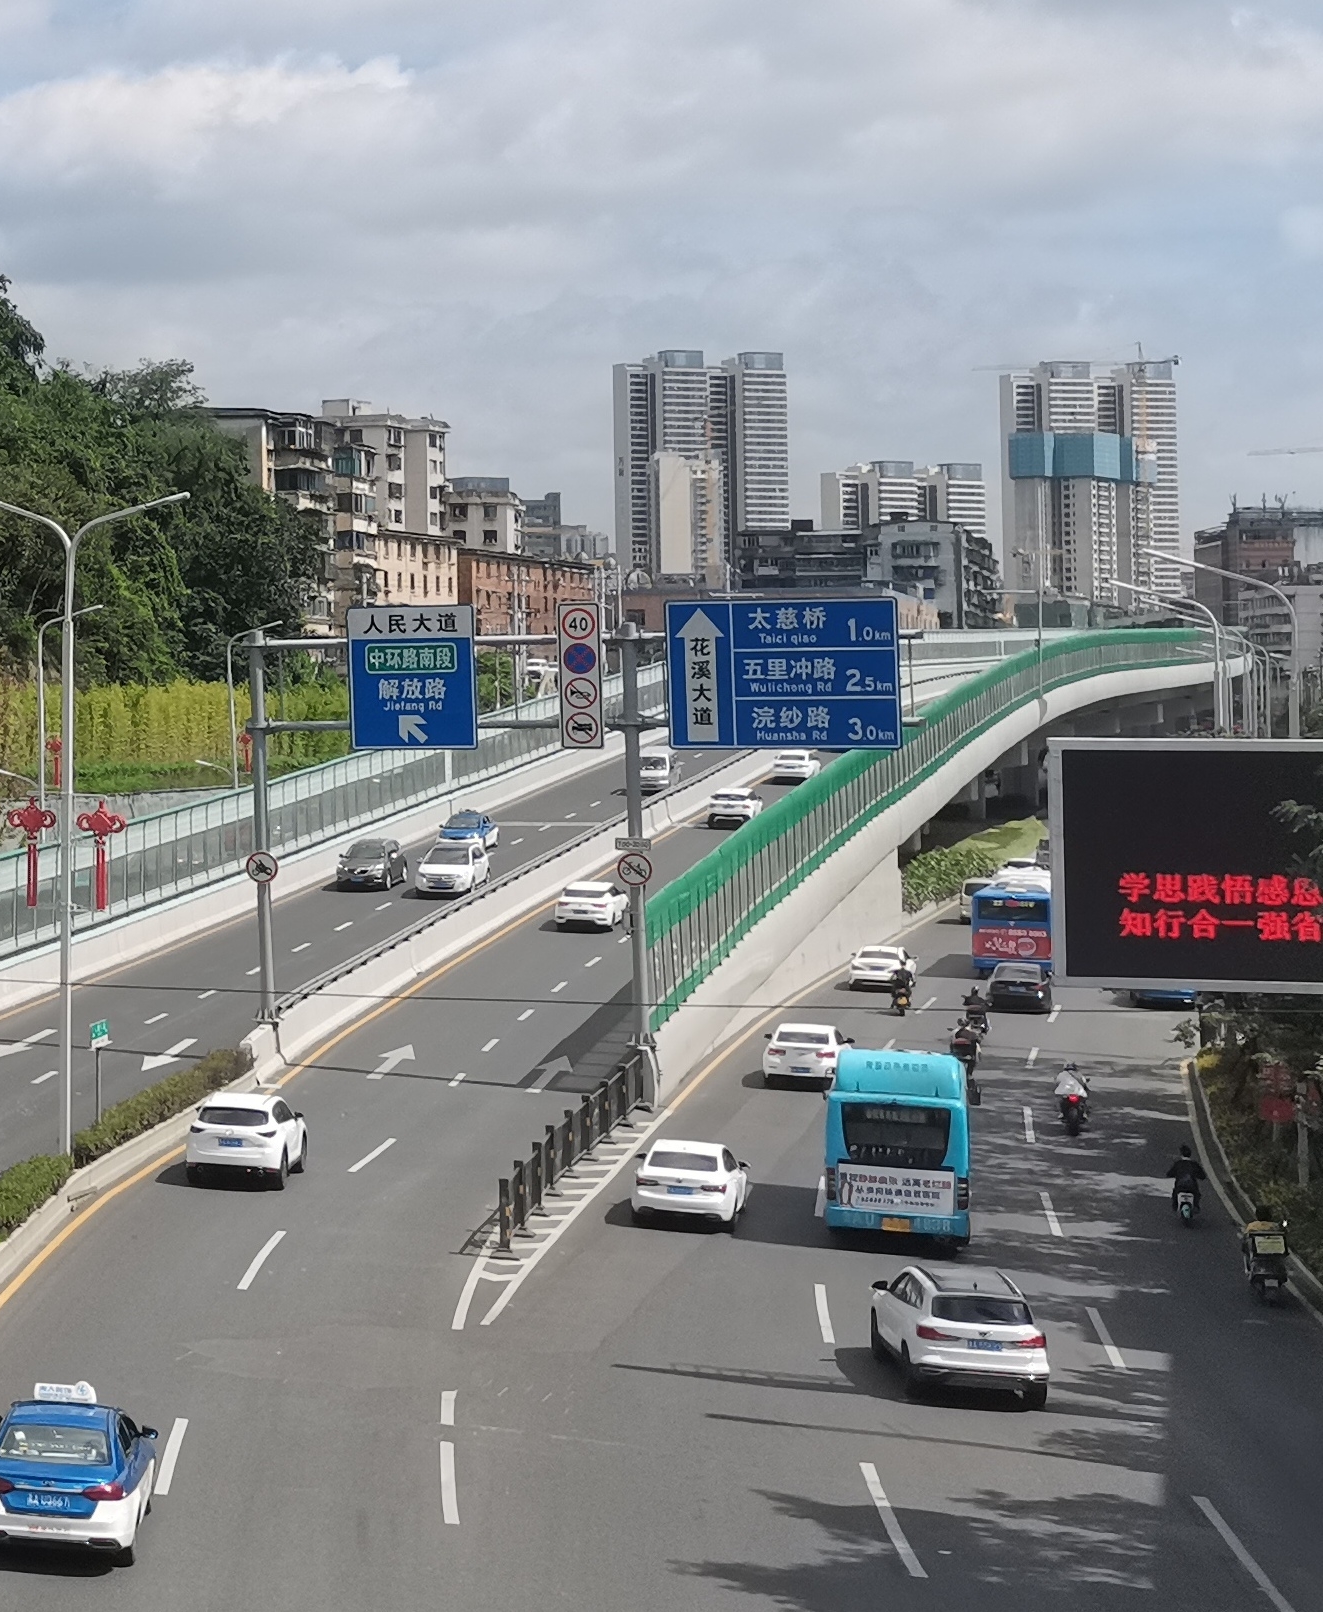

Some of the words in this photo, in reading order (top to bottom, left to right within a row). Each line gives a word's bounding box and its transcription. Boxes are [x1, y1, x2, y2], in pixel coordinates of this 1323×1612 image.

[363, 612, 458, 634] 人民大道
[568, 616, 588, 632] 40
[747, 606, 827, 630] 太慈桥
[758, 633, 787, 644] Taici
[790, 634, 817, 646] qiao
[369, 647, 452, 669] 中环路南段
[742, 657, 837, 681] 五里冲路
[378, 677, 447, 700] 解放路
[689, 637, 714, 726] 花溪大道
[749, 681, 813, 694] Wulichong
[816, 681, 832, 692] Rd
[383, 701, 425, 713] Jiefang
[428, 700, 443, 710] Rd
[751, 706, 831, 729] 浣纱路
[756, 730, 807, 741] Huansha
[812, 730, 828, 741] Rd
